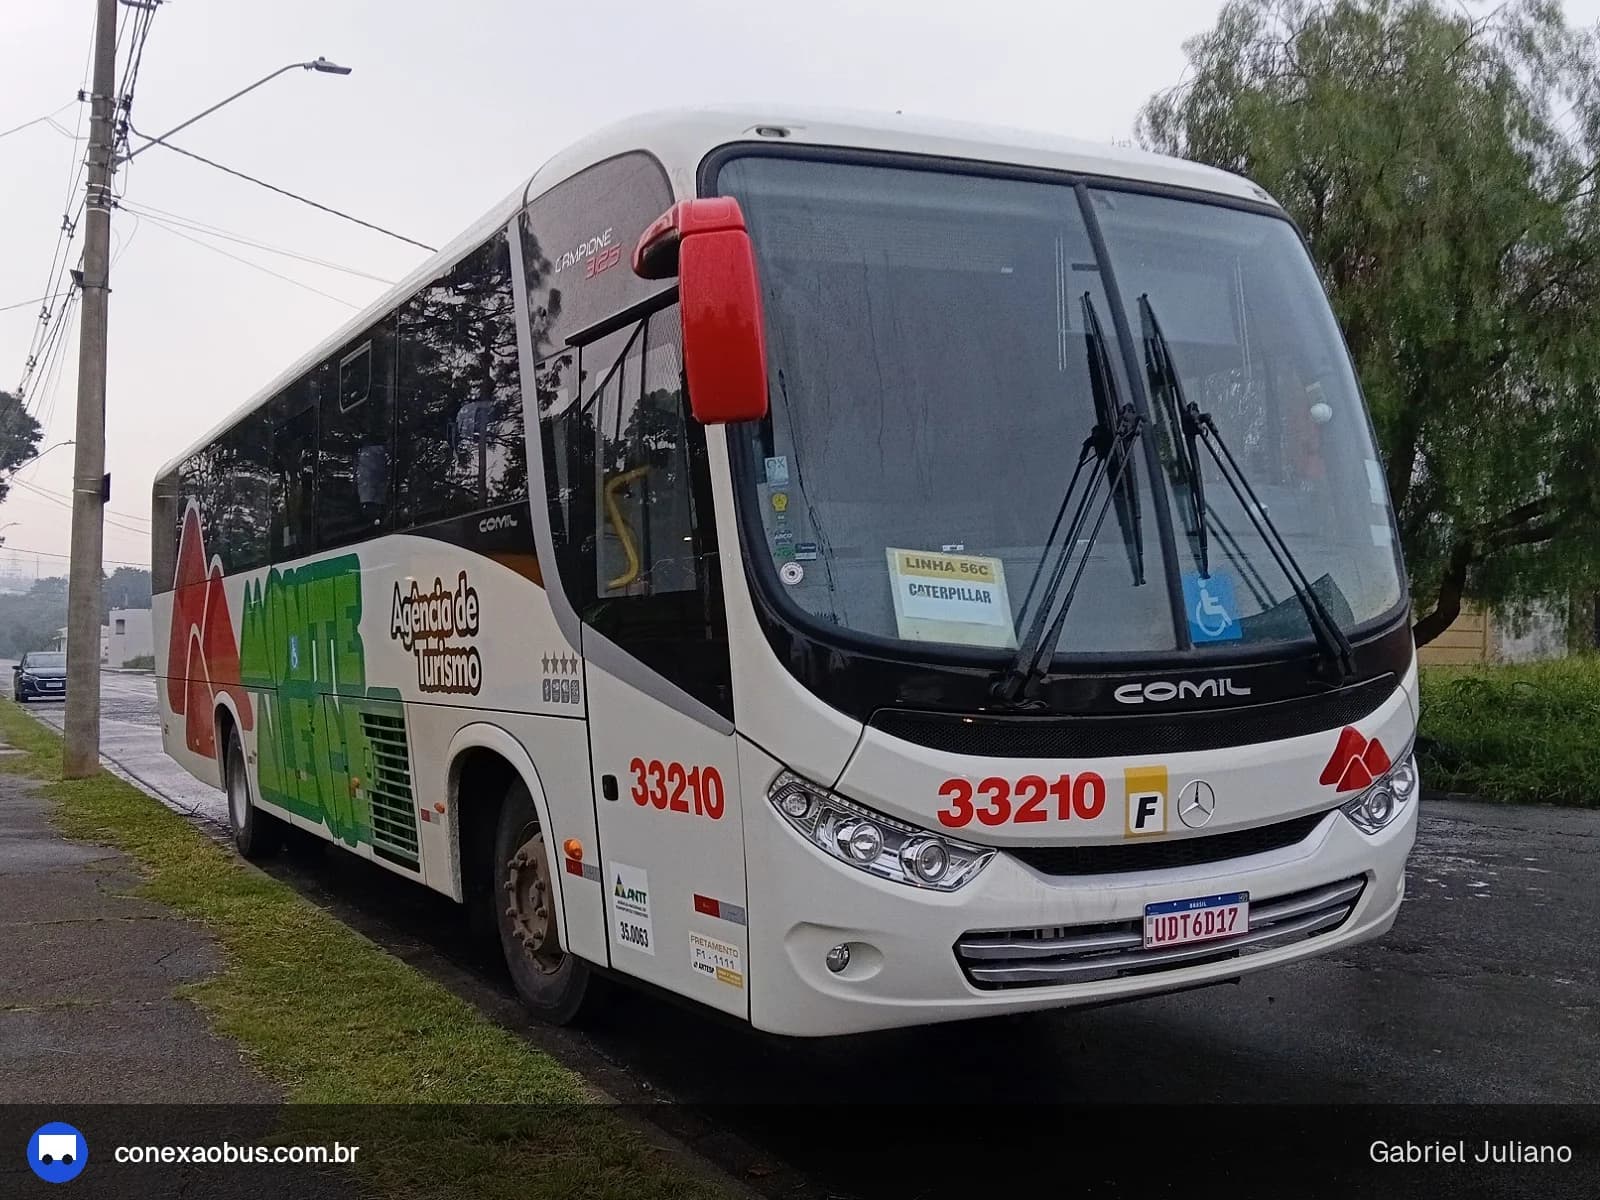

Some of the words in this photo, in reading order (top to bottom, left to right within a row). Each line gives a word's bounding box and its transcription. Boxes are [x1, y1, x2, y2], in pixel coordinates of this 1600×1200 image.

[555, 227, 613, 273] CAMPIONE
[479, 514, 518, 533] COMIL
[905, 556, 956, 573] LINHA
[960, 562, 989, 576] 56C
[391, 576, 454, 651] Agência
[454, 570, 480, 638] de
[908, 583, 992, 604] CATERPILLAR
[239, 553, 366, 690] MONTE
[414, 637, 482, 696] Turismo
[1113, 678, 1251, 704] COMIL
[629, 756, 725, 820] 33210
[936, 771, 1107, 829] 33210
[1134, 795, 1159, 830] F
[619, 920, 649, 949] 35.0063
[1154, 906, 1240, 943] UDT6D17
[690, 935, 739, 959] FRETAMENTO
